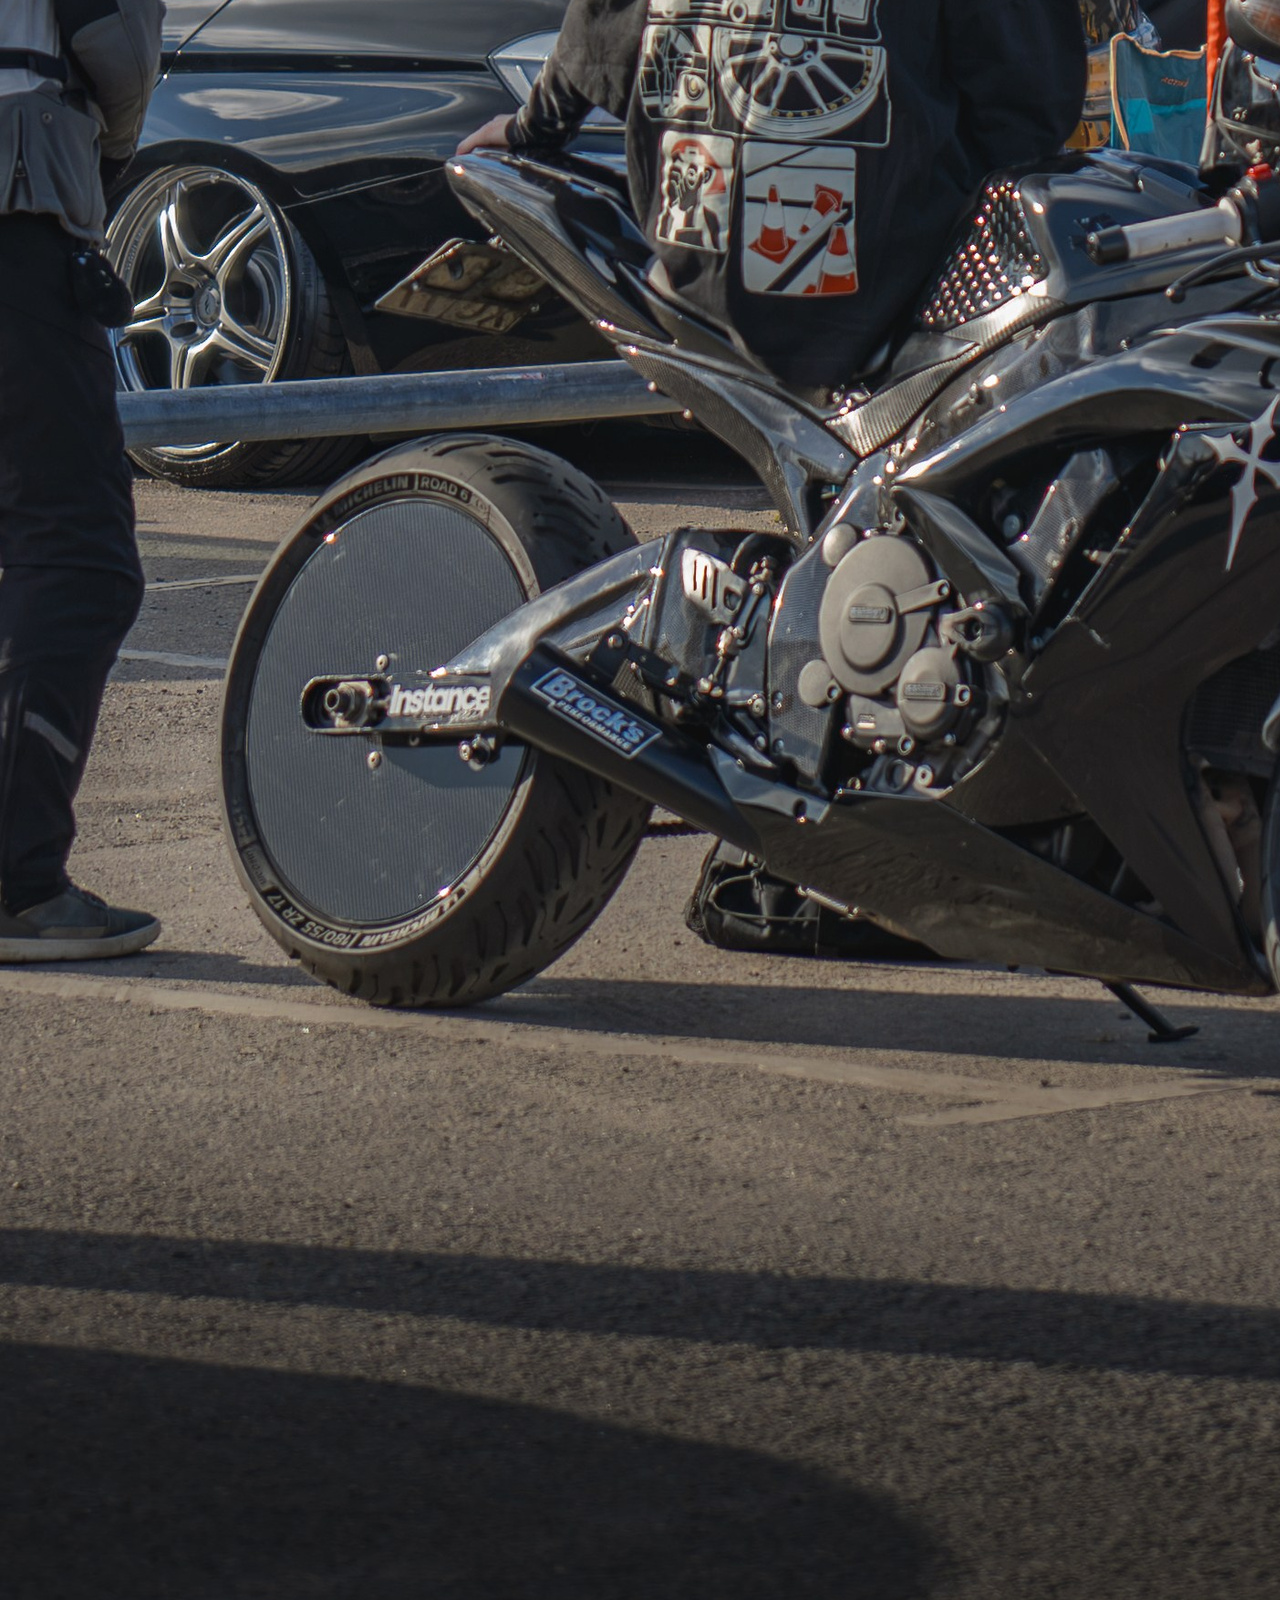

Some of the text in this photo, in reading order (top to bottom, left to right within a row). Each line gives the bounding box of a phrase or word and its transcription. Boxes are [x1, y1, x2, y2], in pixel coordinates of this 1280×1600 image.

[336, 475, 469, 514] MICHELIN ROAD 6
[388, 682, 492, 718] Instance
[541, 672, 646, 744] Brock's
[555, 699, 632, 751] PERFORMANCE
[266, 892, 440, 948] MICHELIN 180/55 ZR 17
